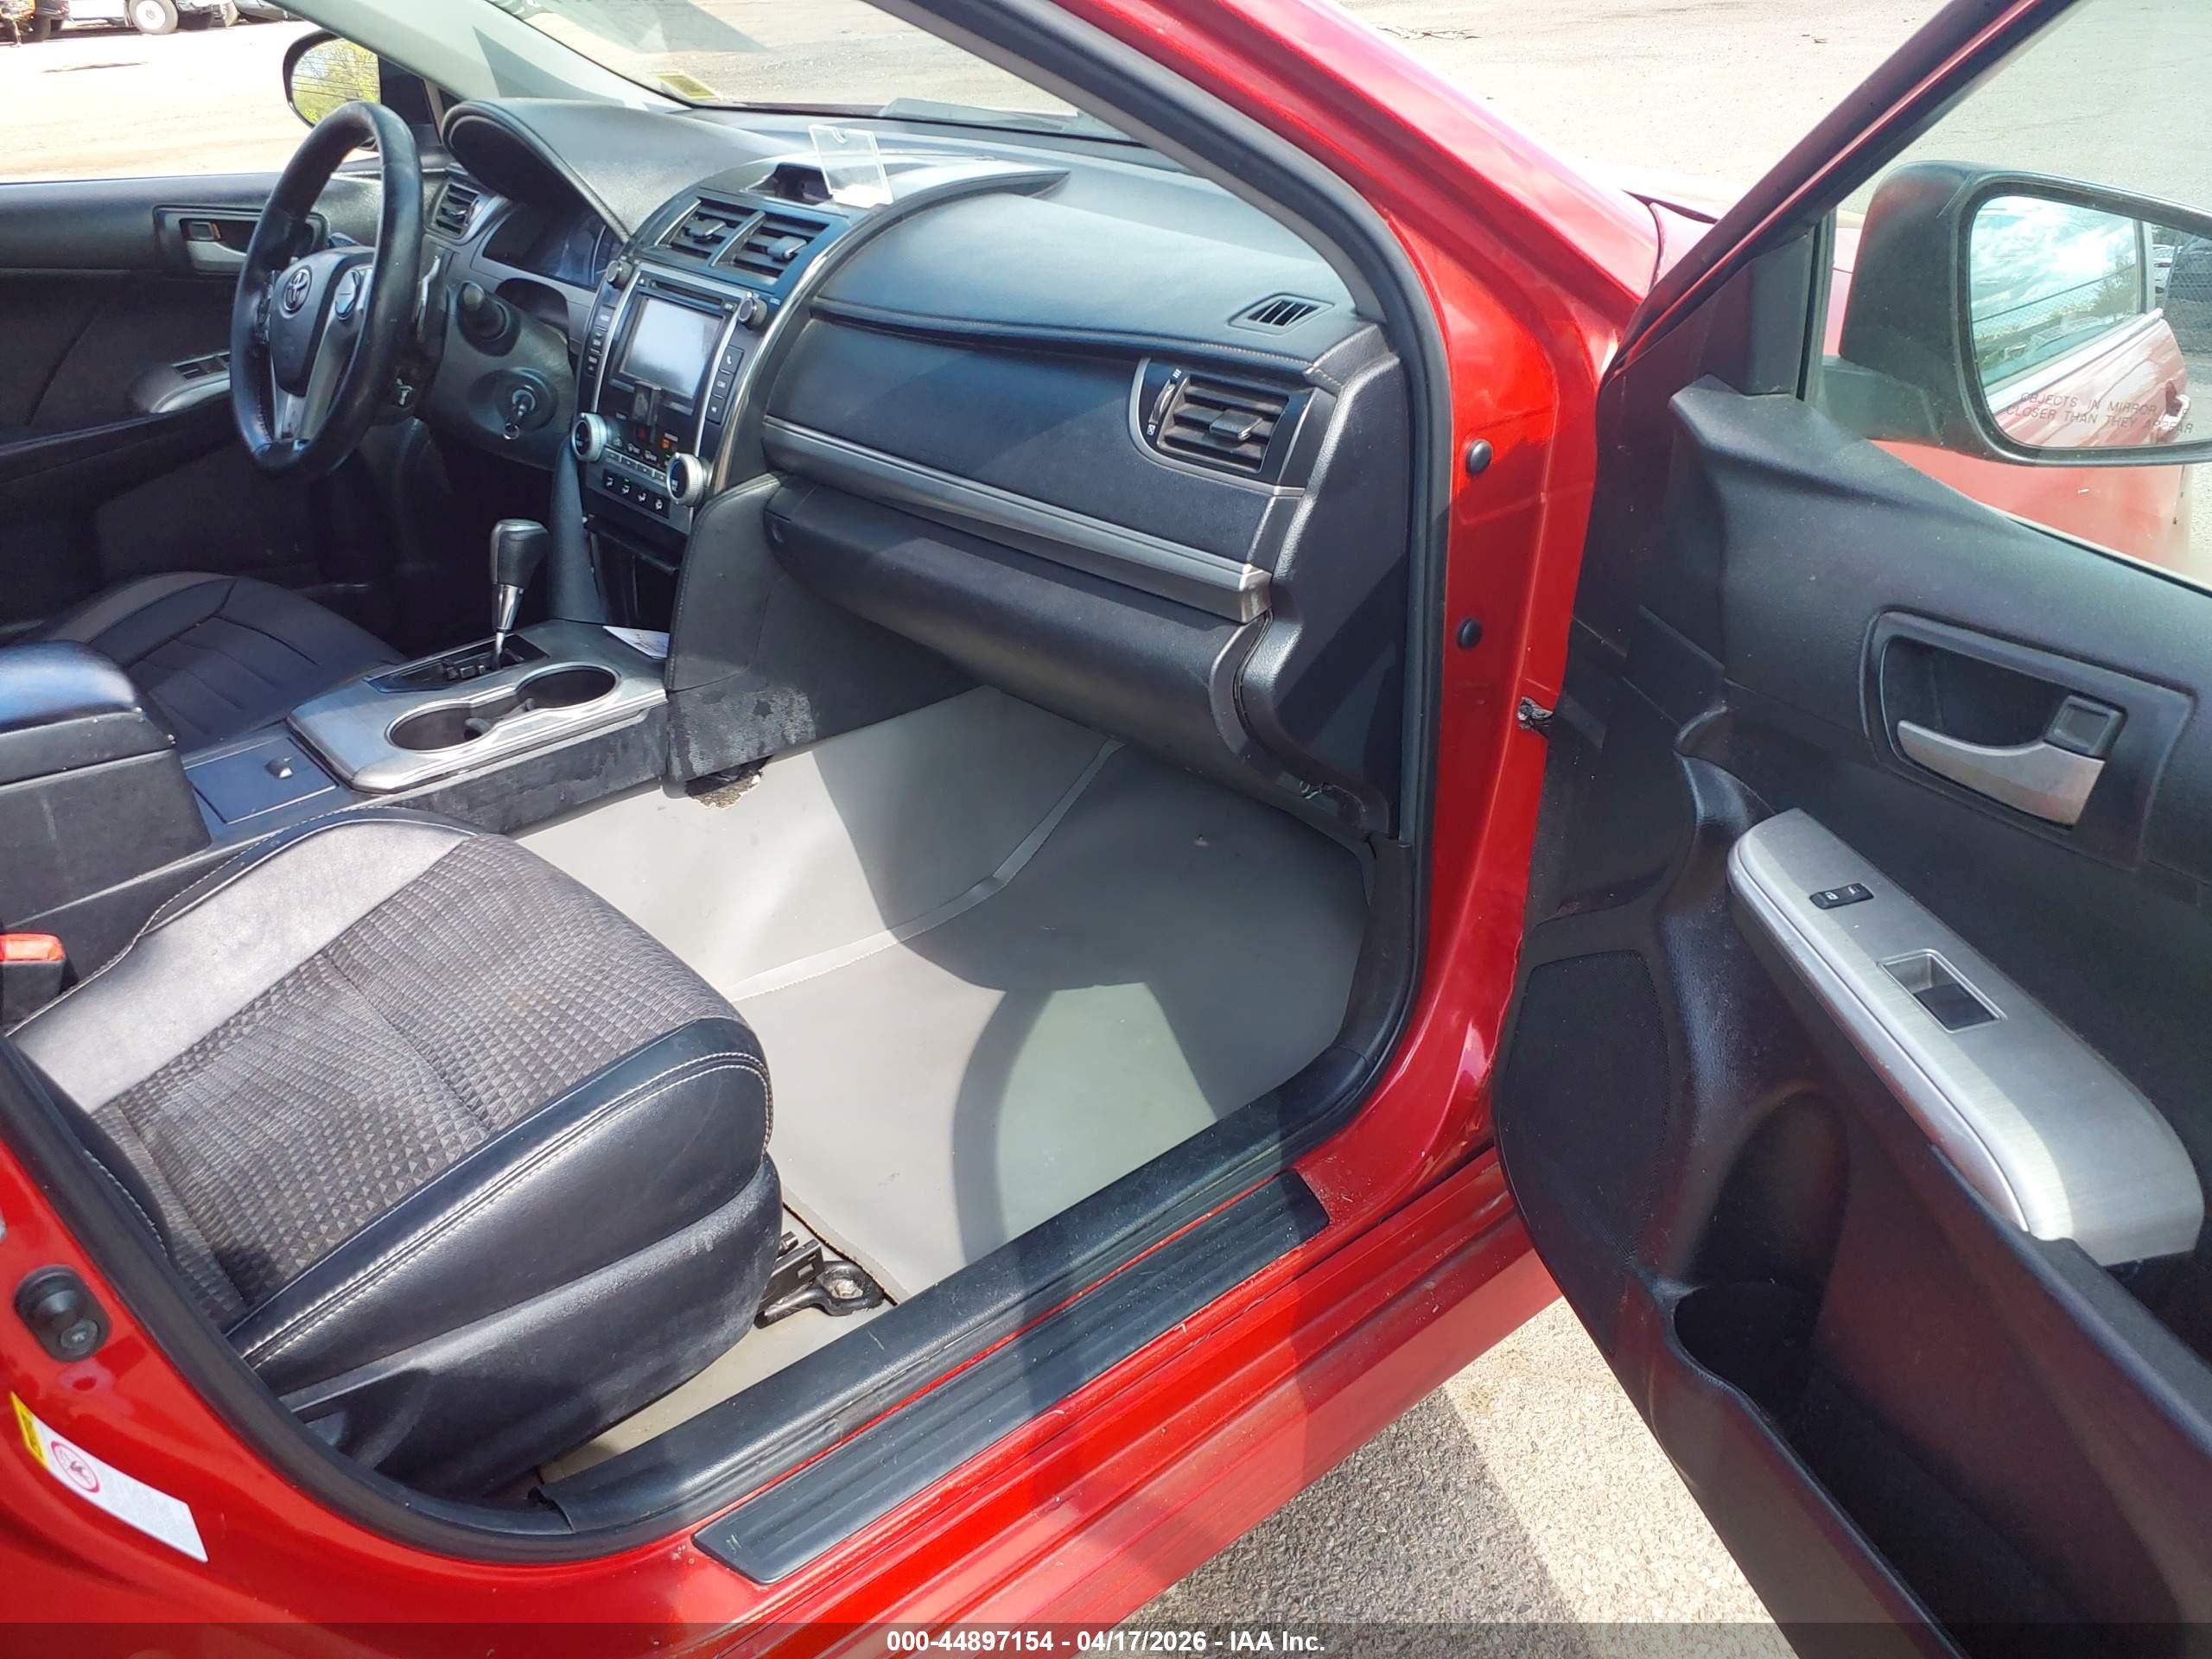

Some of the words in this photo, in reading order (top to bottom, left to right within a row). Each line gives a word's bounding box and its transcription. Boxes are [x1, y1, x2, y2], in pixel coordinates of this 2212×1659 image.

[2020, 391, 2079, 408] OBJECTS
[2087, 398, 2101, 410] IN
[2108, 400, 2158, 416] MIRROR
[2005, 405, 2057, 421] CLOSER
[2064, 410, 2098, 424] THAN
[2107, 414, 2137, 429] THEY
